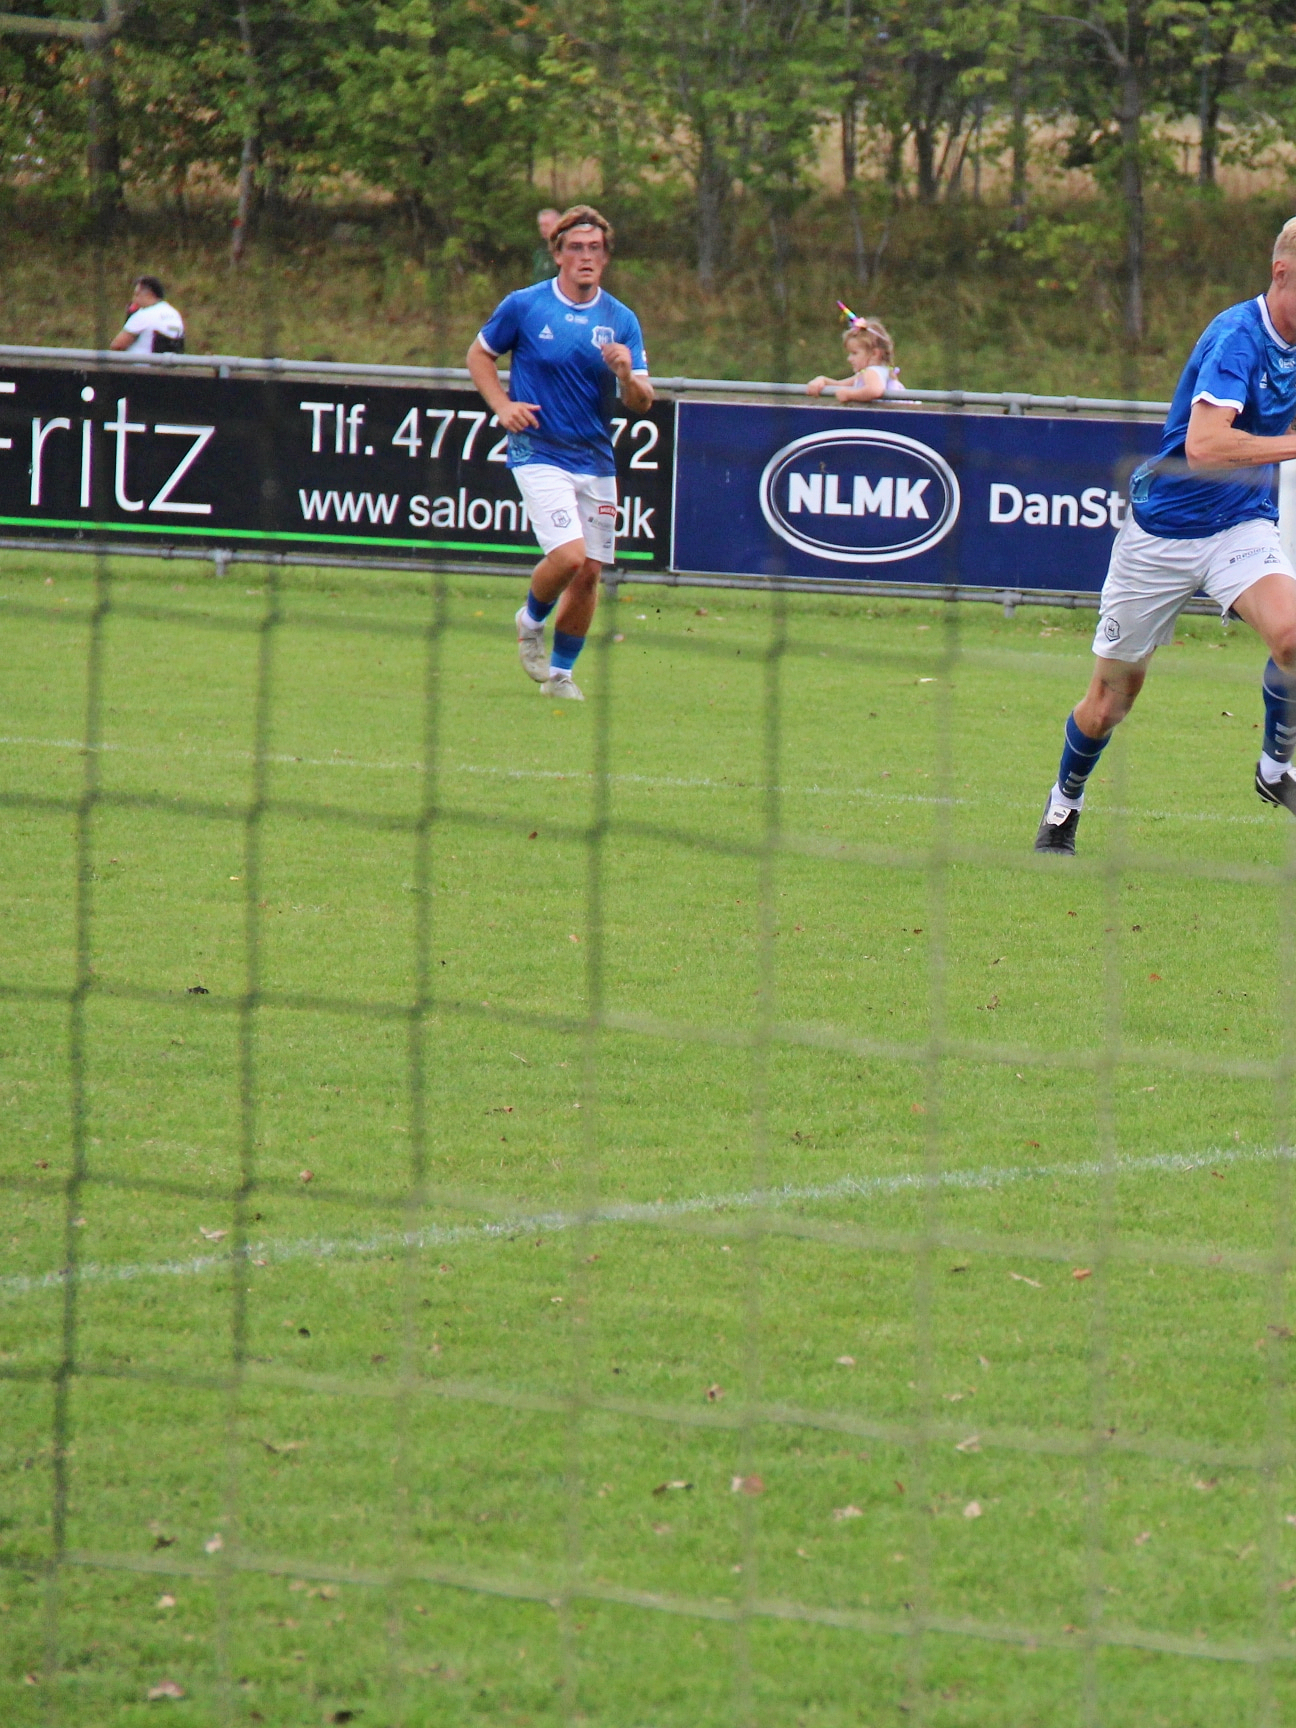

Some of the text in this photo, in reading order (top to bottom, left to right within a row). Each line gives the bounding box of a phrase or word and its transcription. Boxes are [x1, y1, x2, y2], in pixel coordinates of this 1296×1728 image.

[300, 401, 374, 456] Tlf.
[788, 471, 932, 519] NLMK
[989, 482, 1127, 530] DanSt
